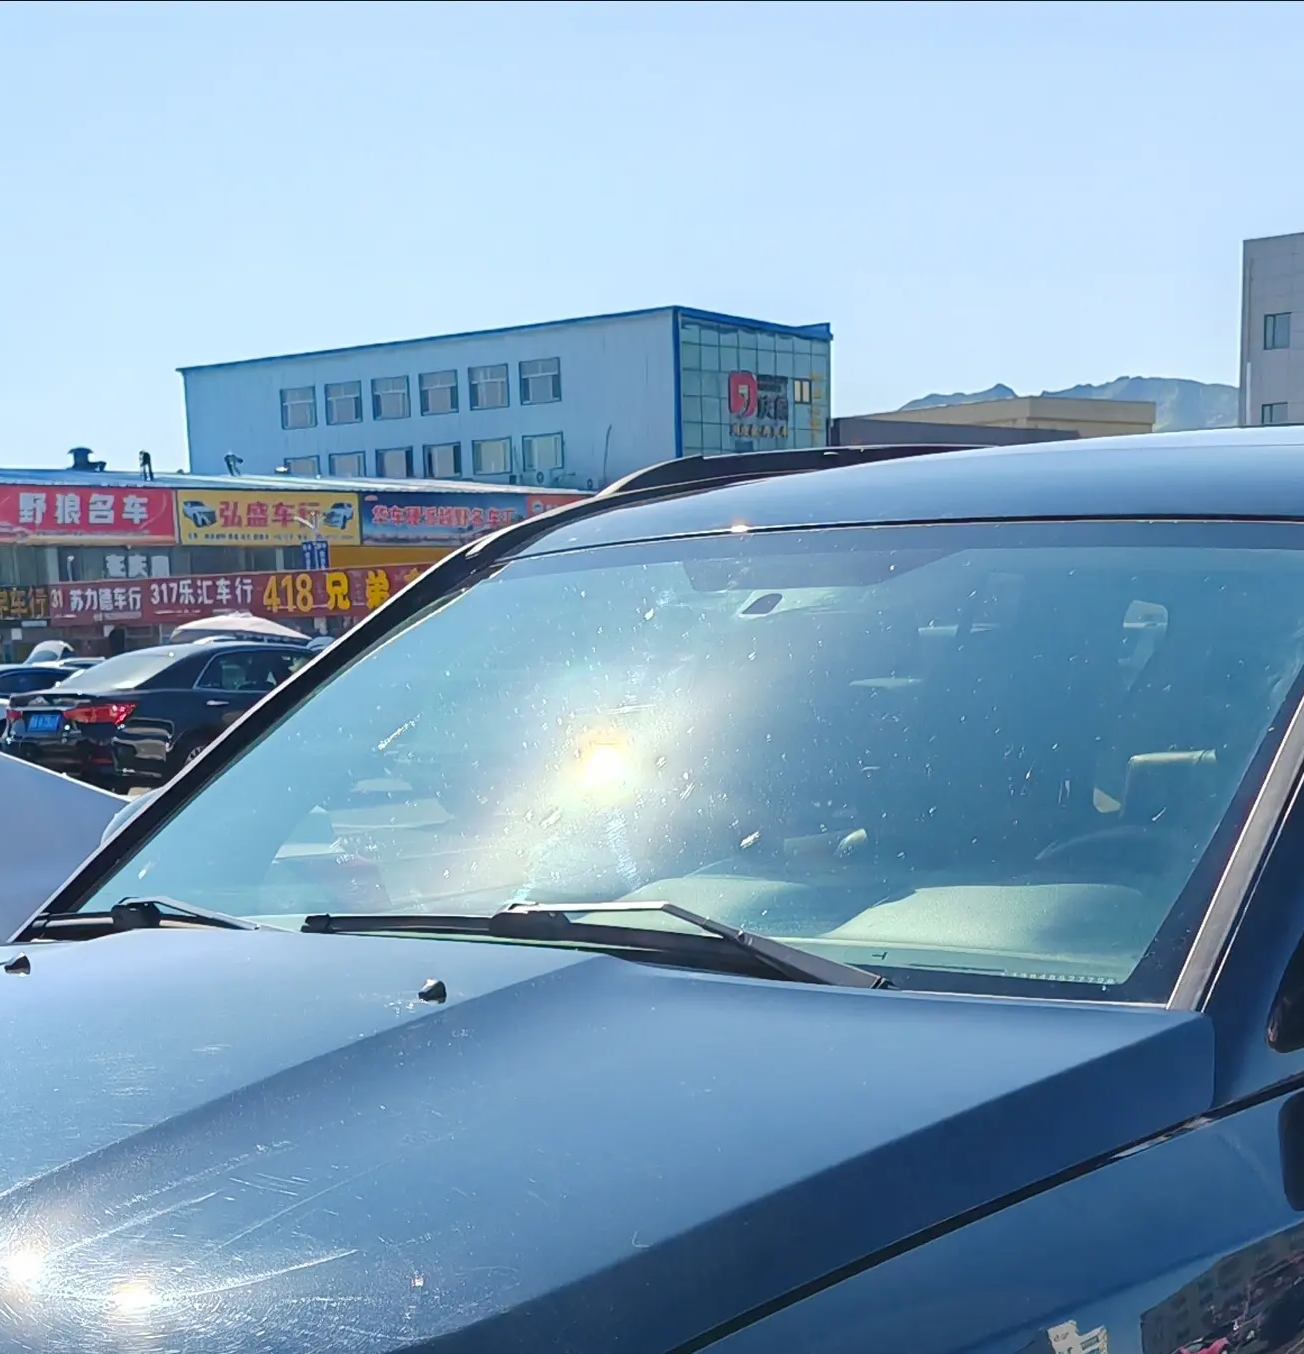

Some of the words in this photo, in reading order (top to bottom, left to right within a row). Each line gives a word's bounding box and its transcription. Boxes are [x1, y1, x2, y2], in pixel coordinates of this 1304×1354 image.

[19, 492, 148, 525] 野狼名车
[218, 501, 321, 529] 弘盛车行
[150, 577, 254, 605] 317乐汇车行
[263, 573, 314, 613] 418
[326, 569, 417, 610] 兄弟
